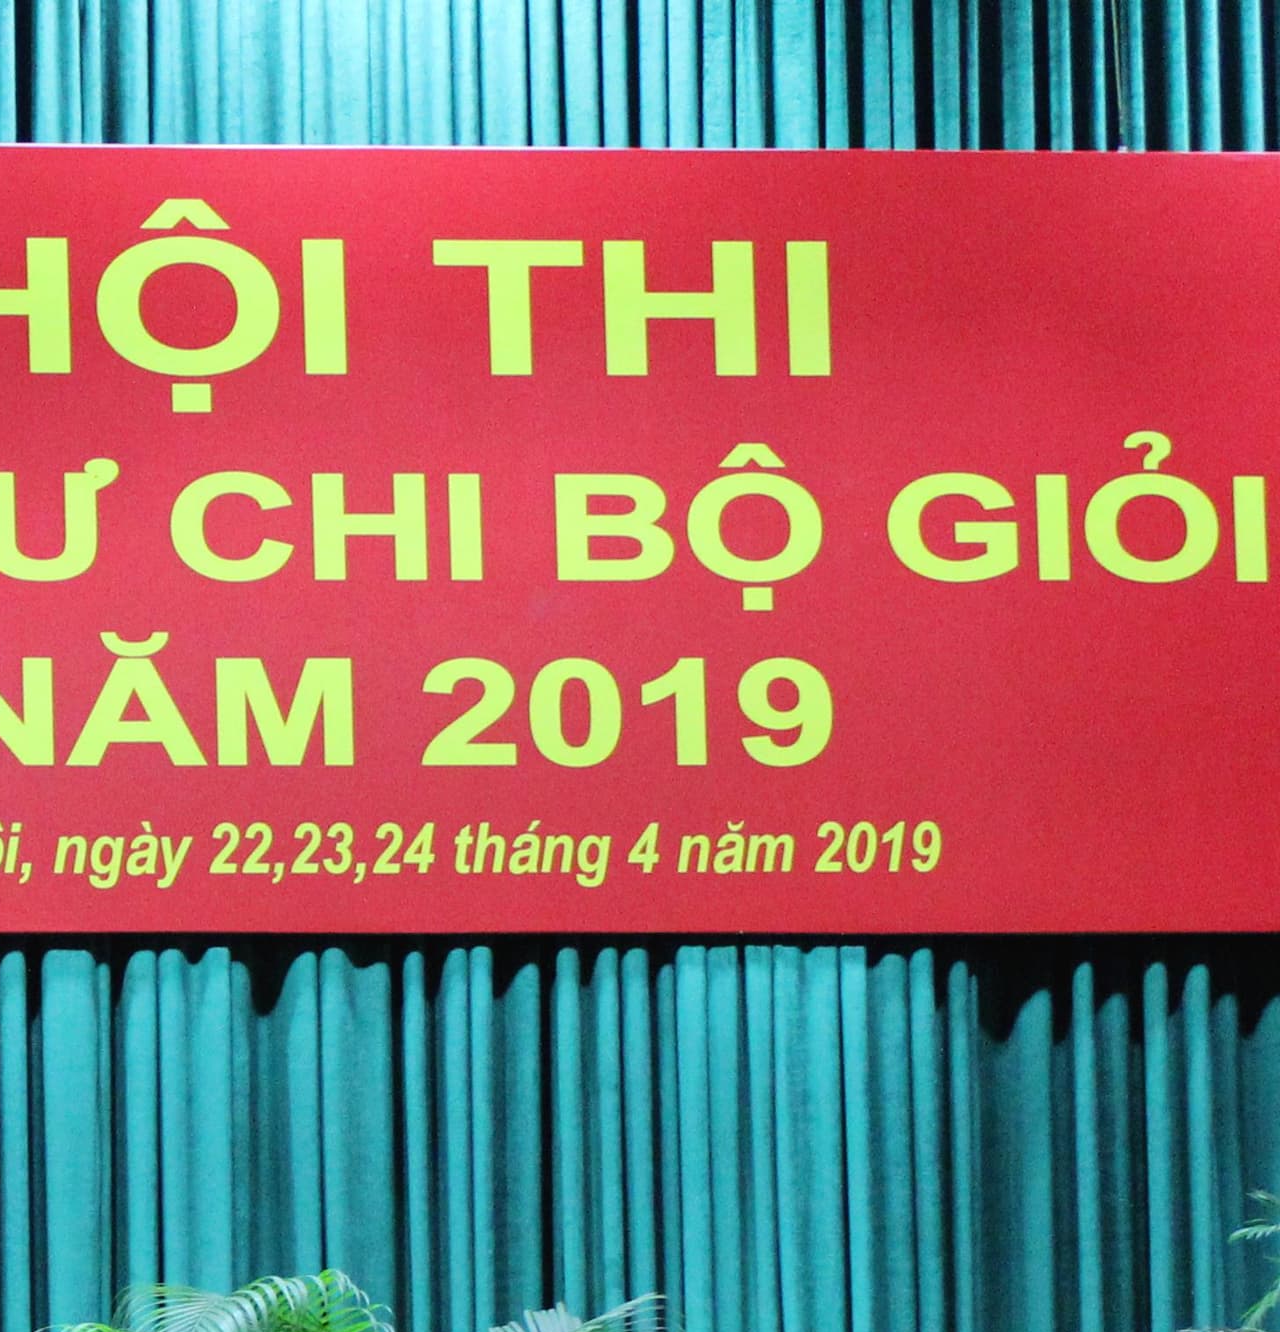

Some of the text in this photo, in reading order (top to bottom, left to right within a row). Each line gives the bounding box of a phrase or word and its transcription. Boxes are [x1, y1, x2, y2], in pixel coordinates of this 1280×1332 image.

[431, 238, 832, 377] THI
[169, 470, 485, 583] CHI
[553, 442, 824, 612] BỘ
[886, 430, 1269, 584] GIỎI
[420, 656, 834, 769] 2019
[53, 820, 194, 890] ngày
[208, 821, 436, 885] 22,23,24
[453, 819, 612, 888] tháng
[627, 821, 661, 874] 4
[677, 820, 796, 875] năm
[814, 820, 943, 874] 2019
